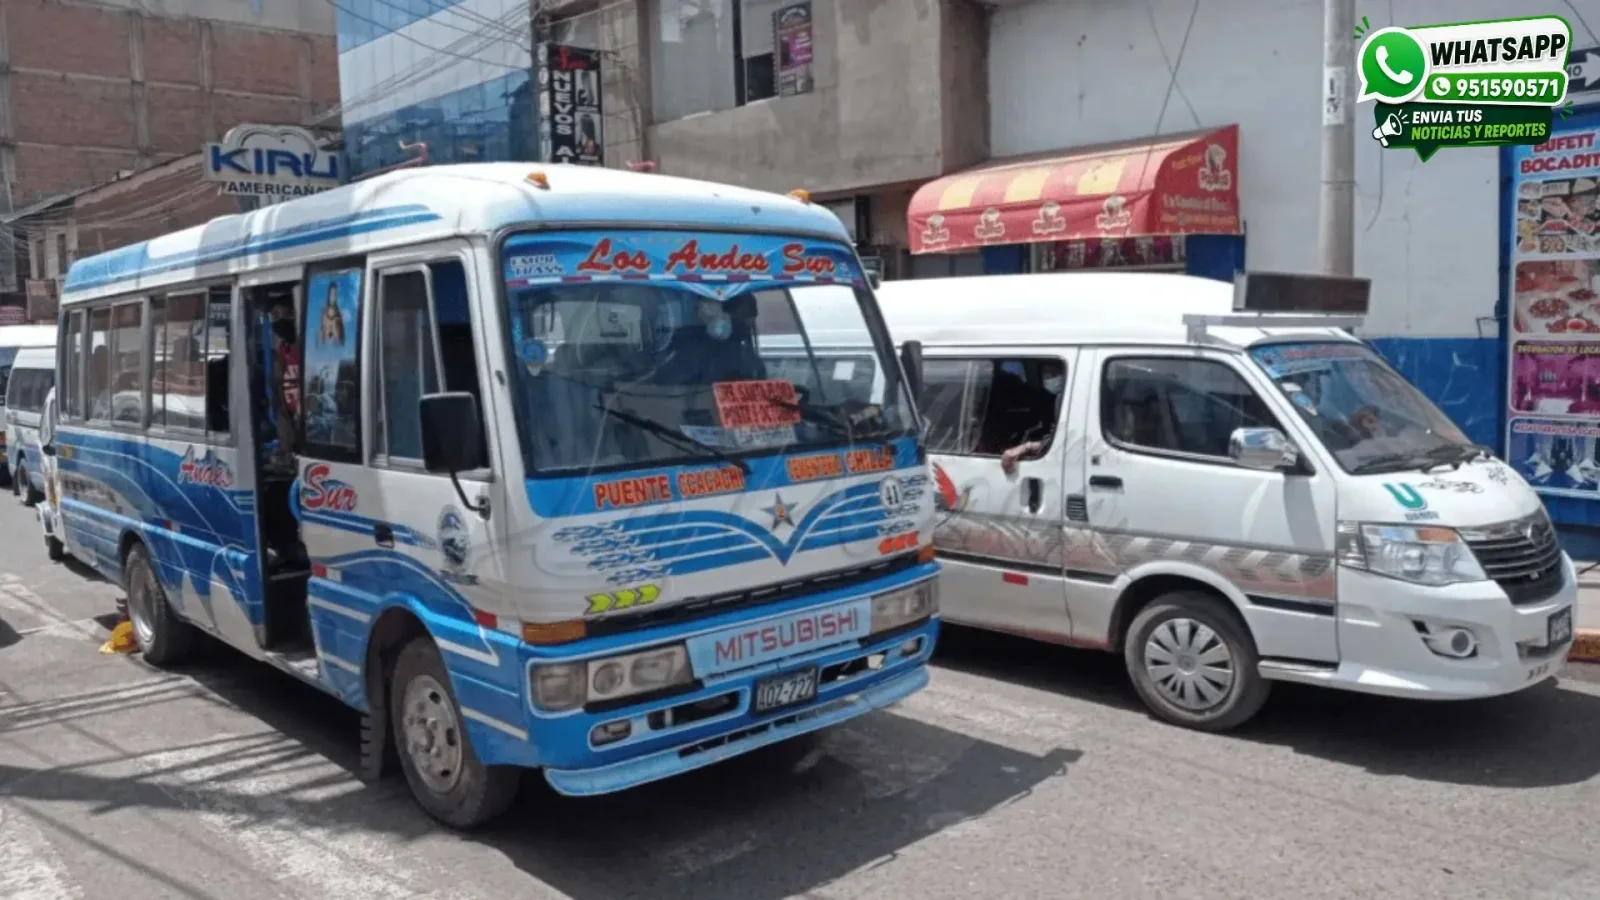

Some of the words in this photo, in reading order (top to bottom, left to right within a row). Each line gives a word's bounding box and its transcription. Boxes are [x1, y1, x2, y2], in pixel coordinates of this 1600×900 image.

[553, 69, 573, 135] NUEVOS
[211, 145, 338, 178] KIRU
[576, 238, 651, 272] Los
[664, 239, 769, 273] Andes
[782, 243, 837, 274] Sur
[304, 462, 358, 512] Sur
[593, 475, 672, 509] PUENTE
[886, 484, 900, 506] 41
[714, 607, 858, 666] MITSUBISHI
